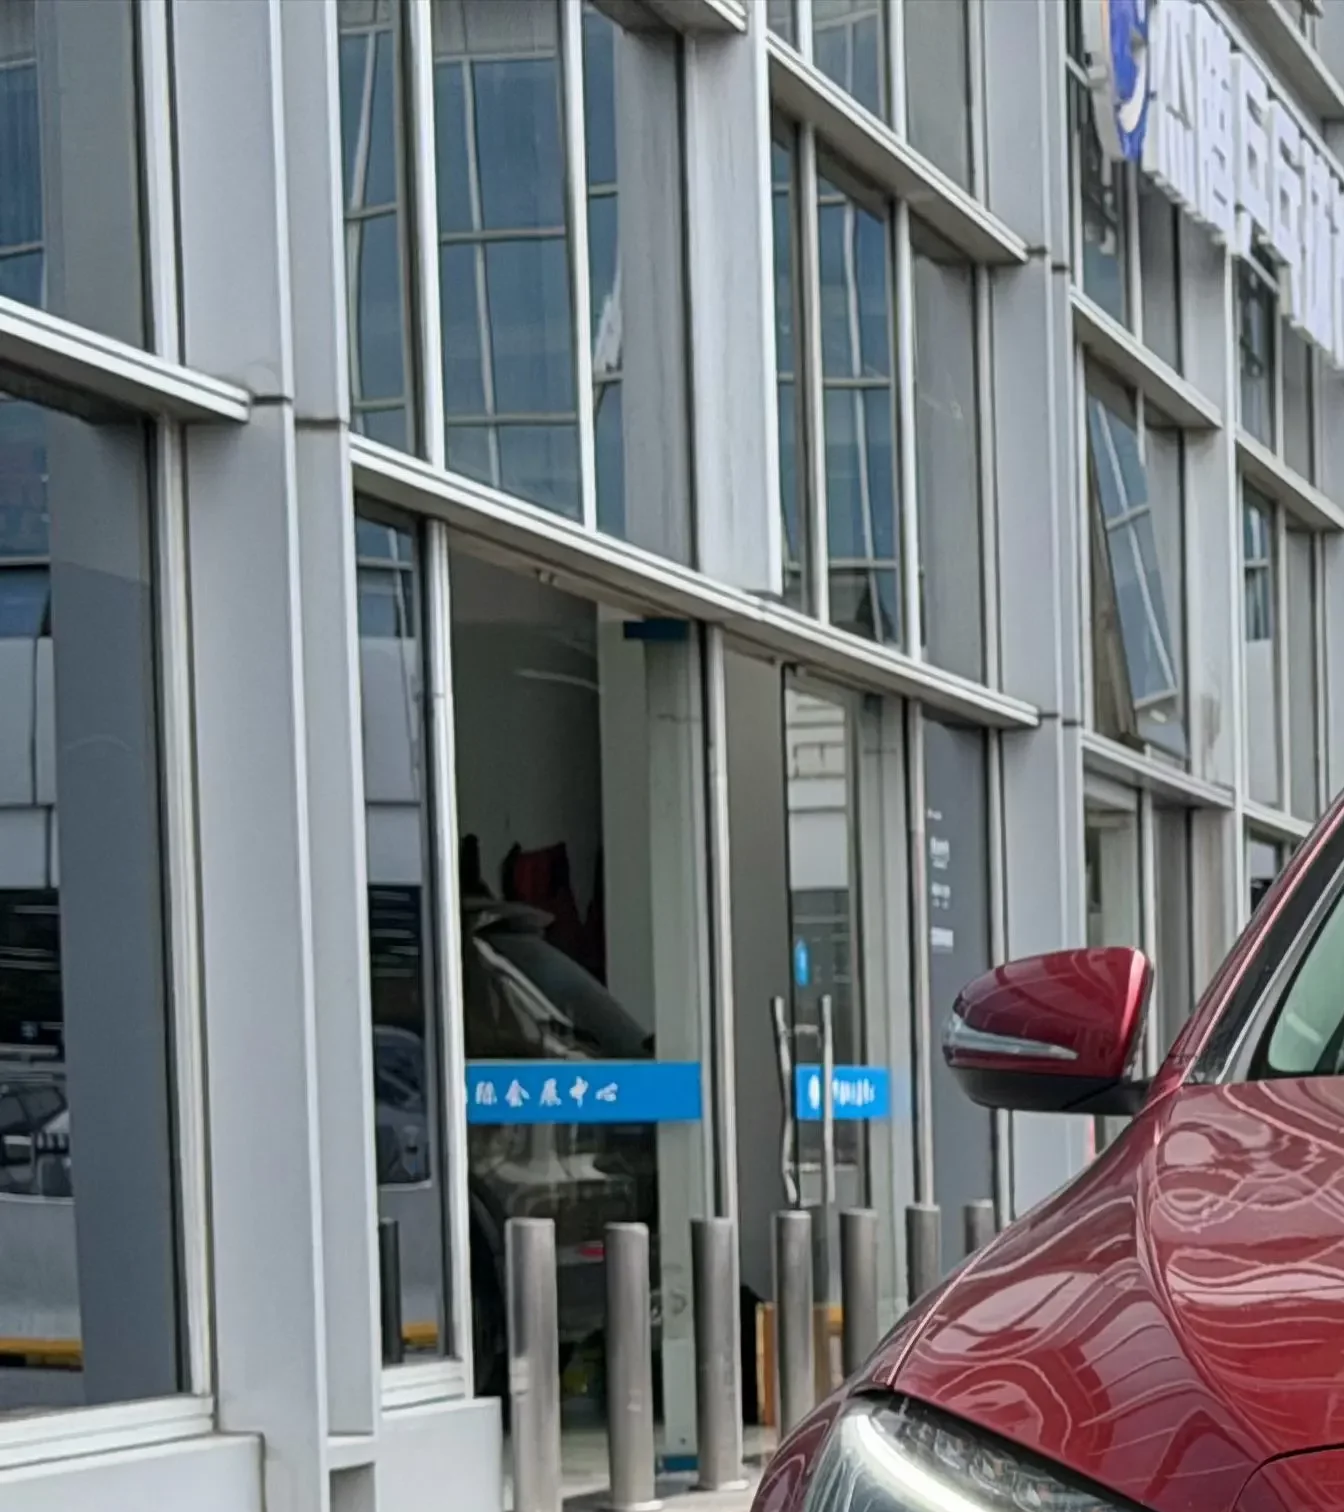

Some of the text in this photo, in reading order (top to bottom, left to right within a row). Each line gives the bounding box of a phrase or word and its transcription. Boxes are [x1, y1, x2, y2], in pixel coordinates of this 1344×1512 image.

[464, 1075, 619, 1108] 际会展中心
